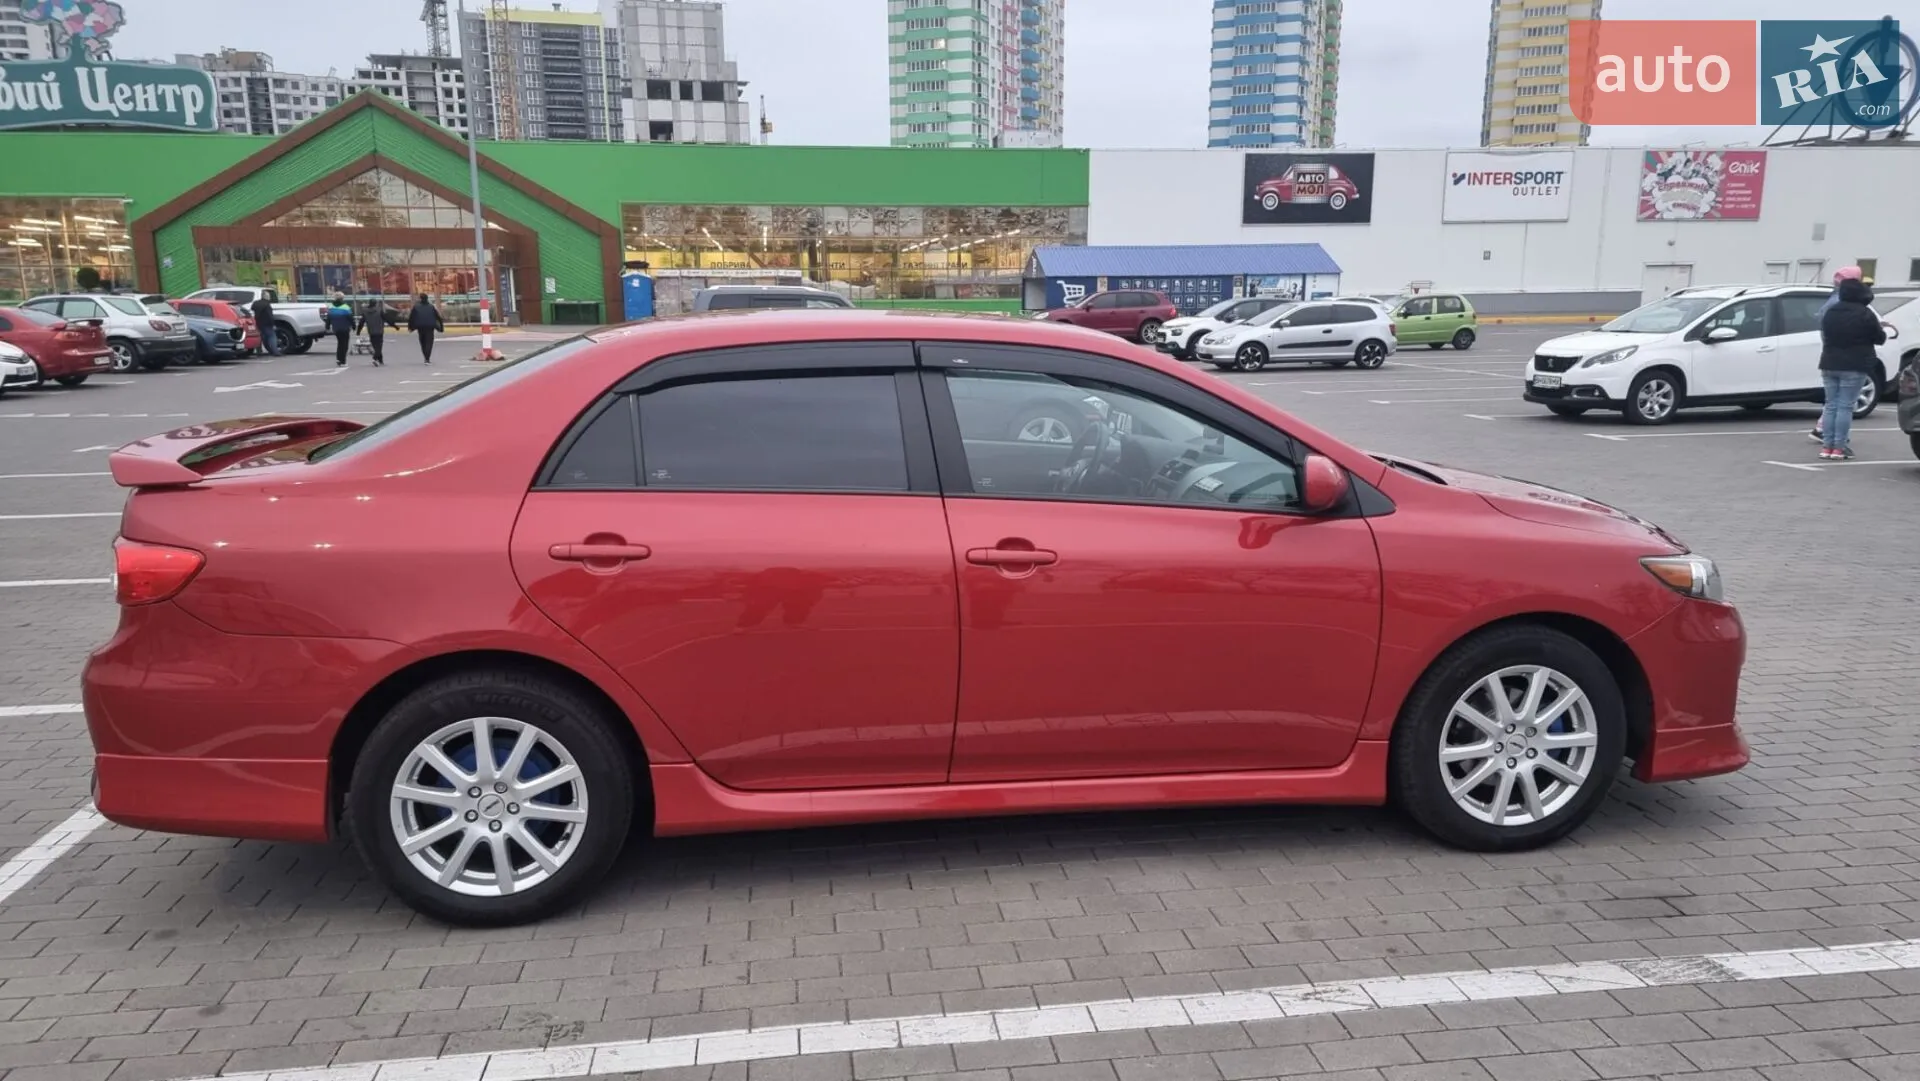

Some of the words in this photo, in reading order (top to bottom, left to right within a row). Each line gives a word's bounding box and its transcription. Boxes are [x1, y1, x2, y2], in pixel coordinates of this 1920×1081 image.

[74, 67, 204, 126] Центр
[1297, 173, 1325, 183] АВТО
[1467, 171, 1564, 186] INTERSPORT
[1296, 184, 1325, 195] МОЛ
[1513, 186, 1561, 196] OUTLET
